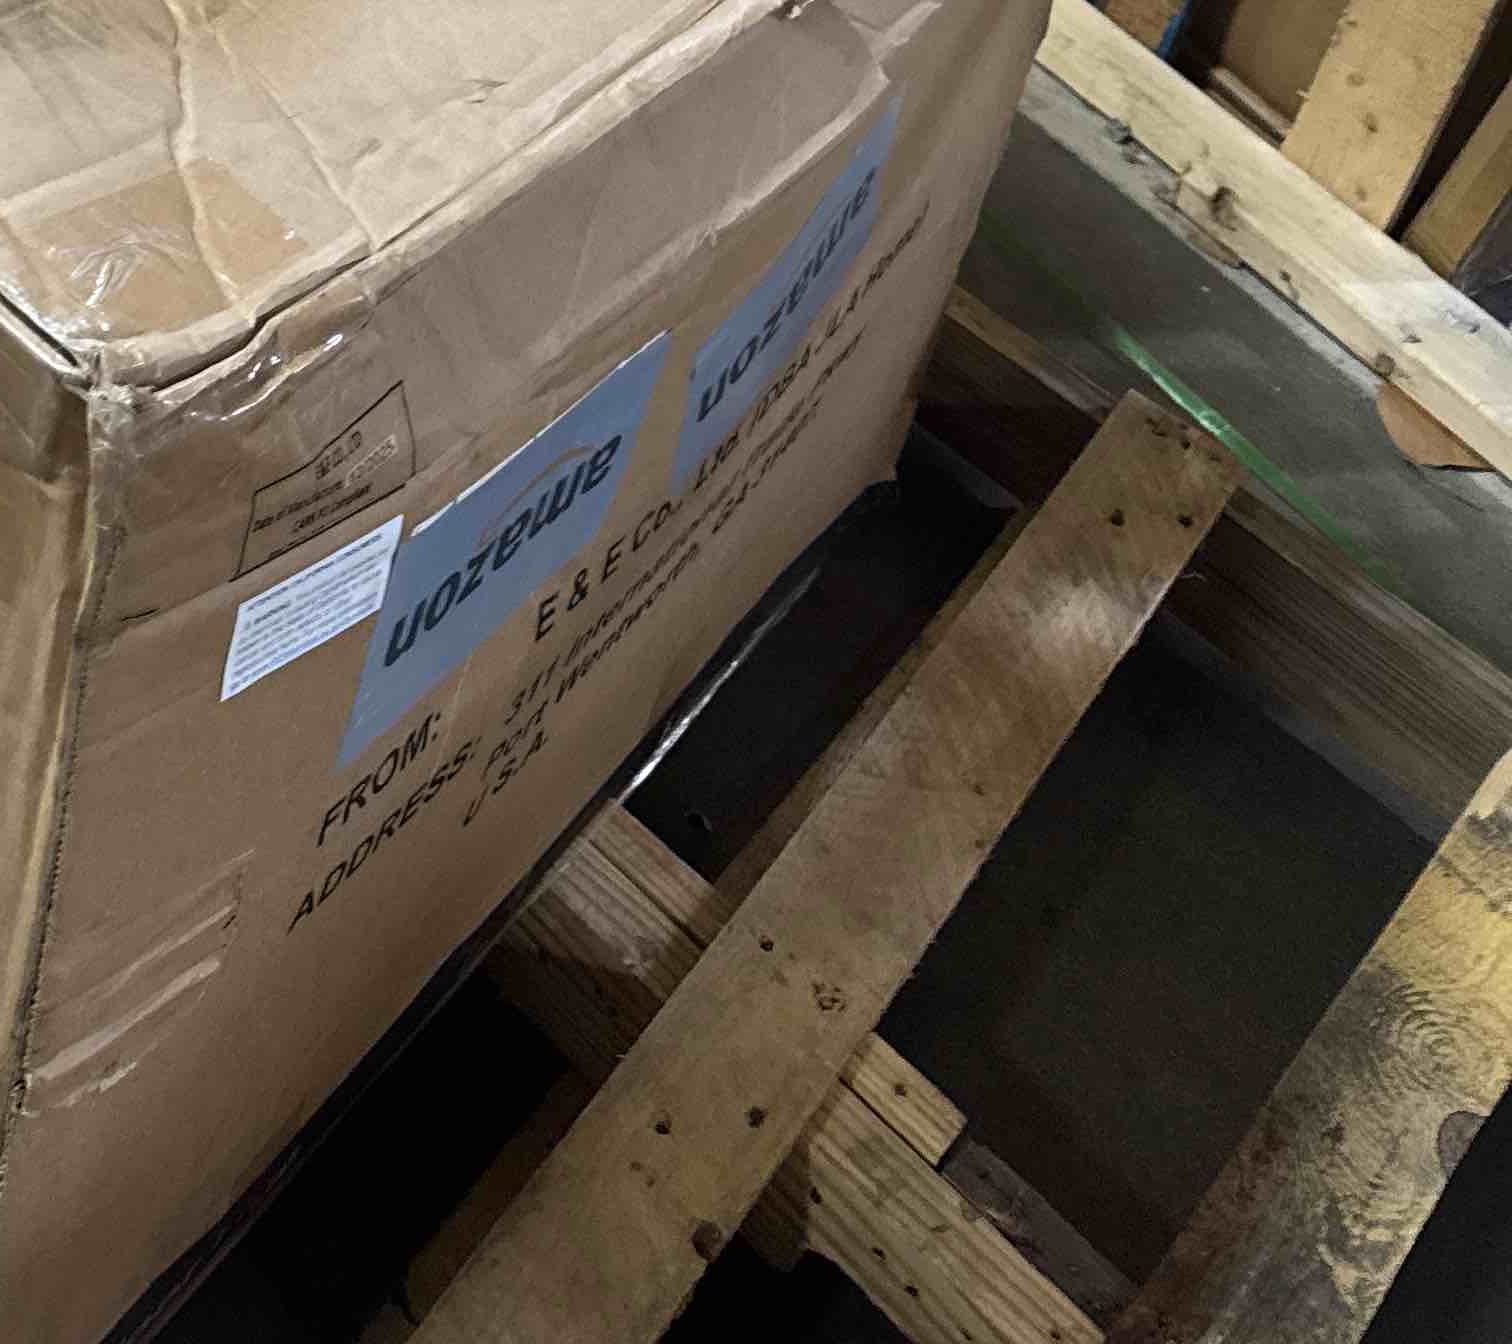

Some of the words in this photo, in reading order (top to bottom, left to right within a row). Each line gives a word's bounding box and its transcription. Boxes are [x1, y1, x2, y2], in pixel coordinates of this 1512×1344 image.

[384, 434, 623, 667] amazon
[317, 711, 441, 848] FROM:
[535, 589, 561, 643] E
[567, 567, 589, 611] &
[600, 534, 627, 584] E
[287, 735, 482, 936] ADDRESS:
